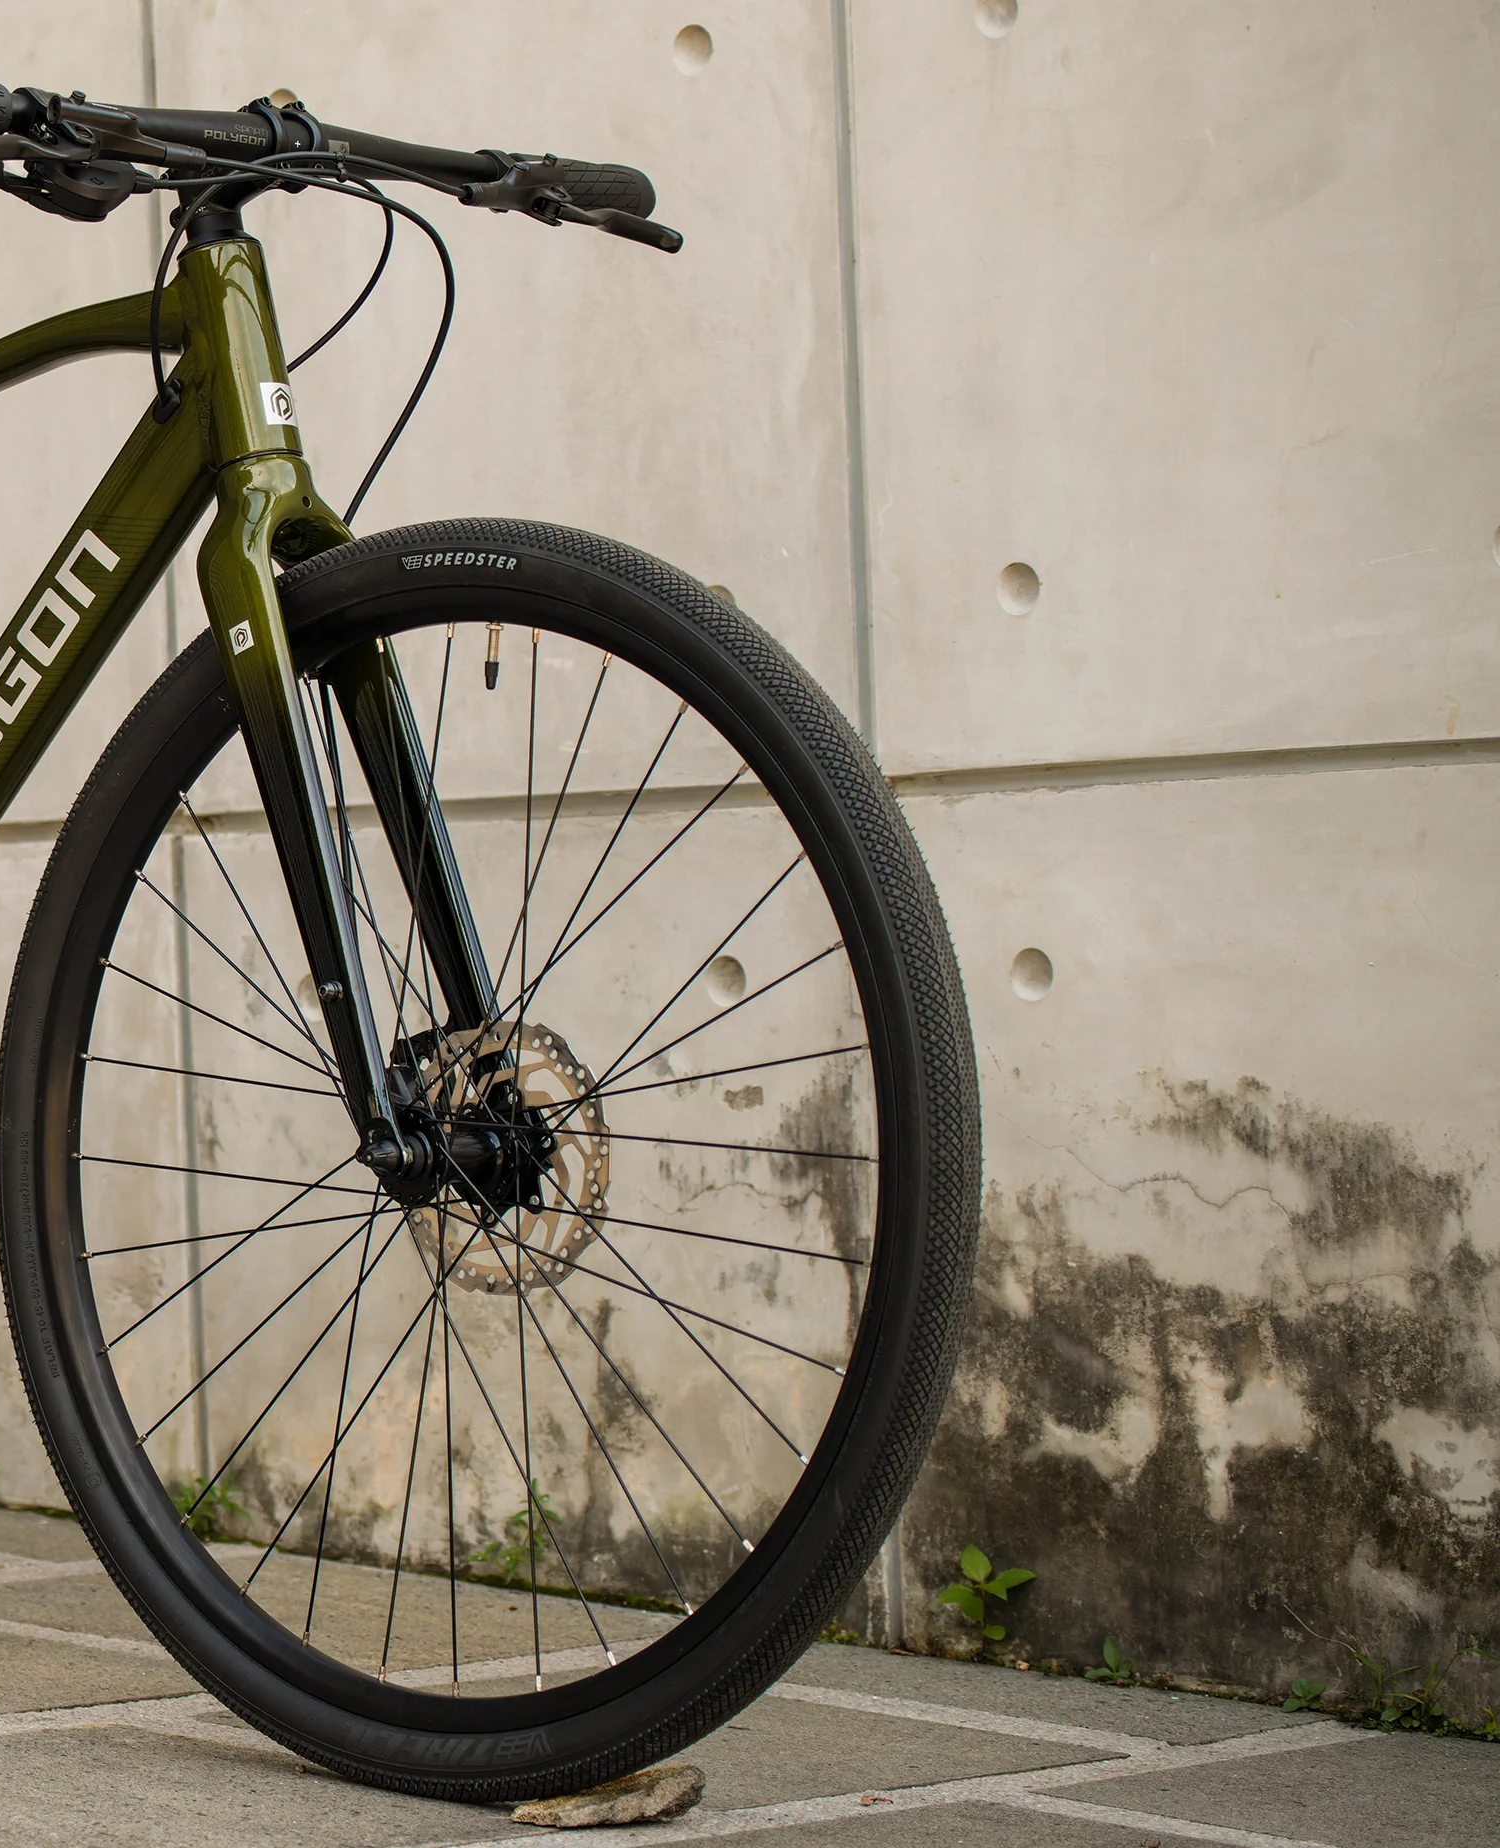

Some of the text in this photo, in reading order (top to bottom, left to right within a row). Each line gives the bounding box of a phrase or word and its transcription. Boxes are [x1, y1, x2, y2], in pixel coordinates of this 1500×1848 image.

[204, 129, 266, 147] POLYGON
[423, 552, 518, 571] SPEEDSTER
[41, 1337, 61, 1379] INFLATE
